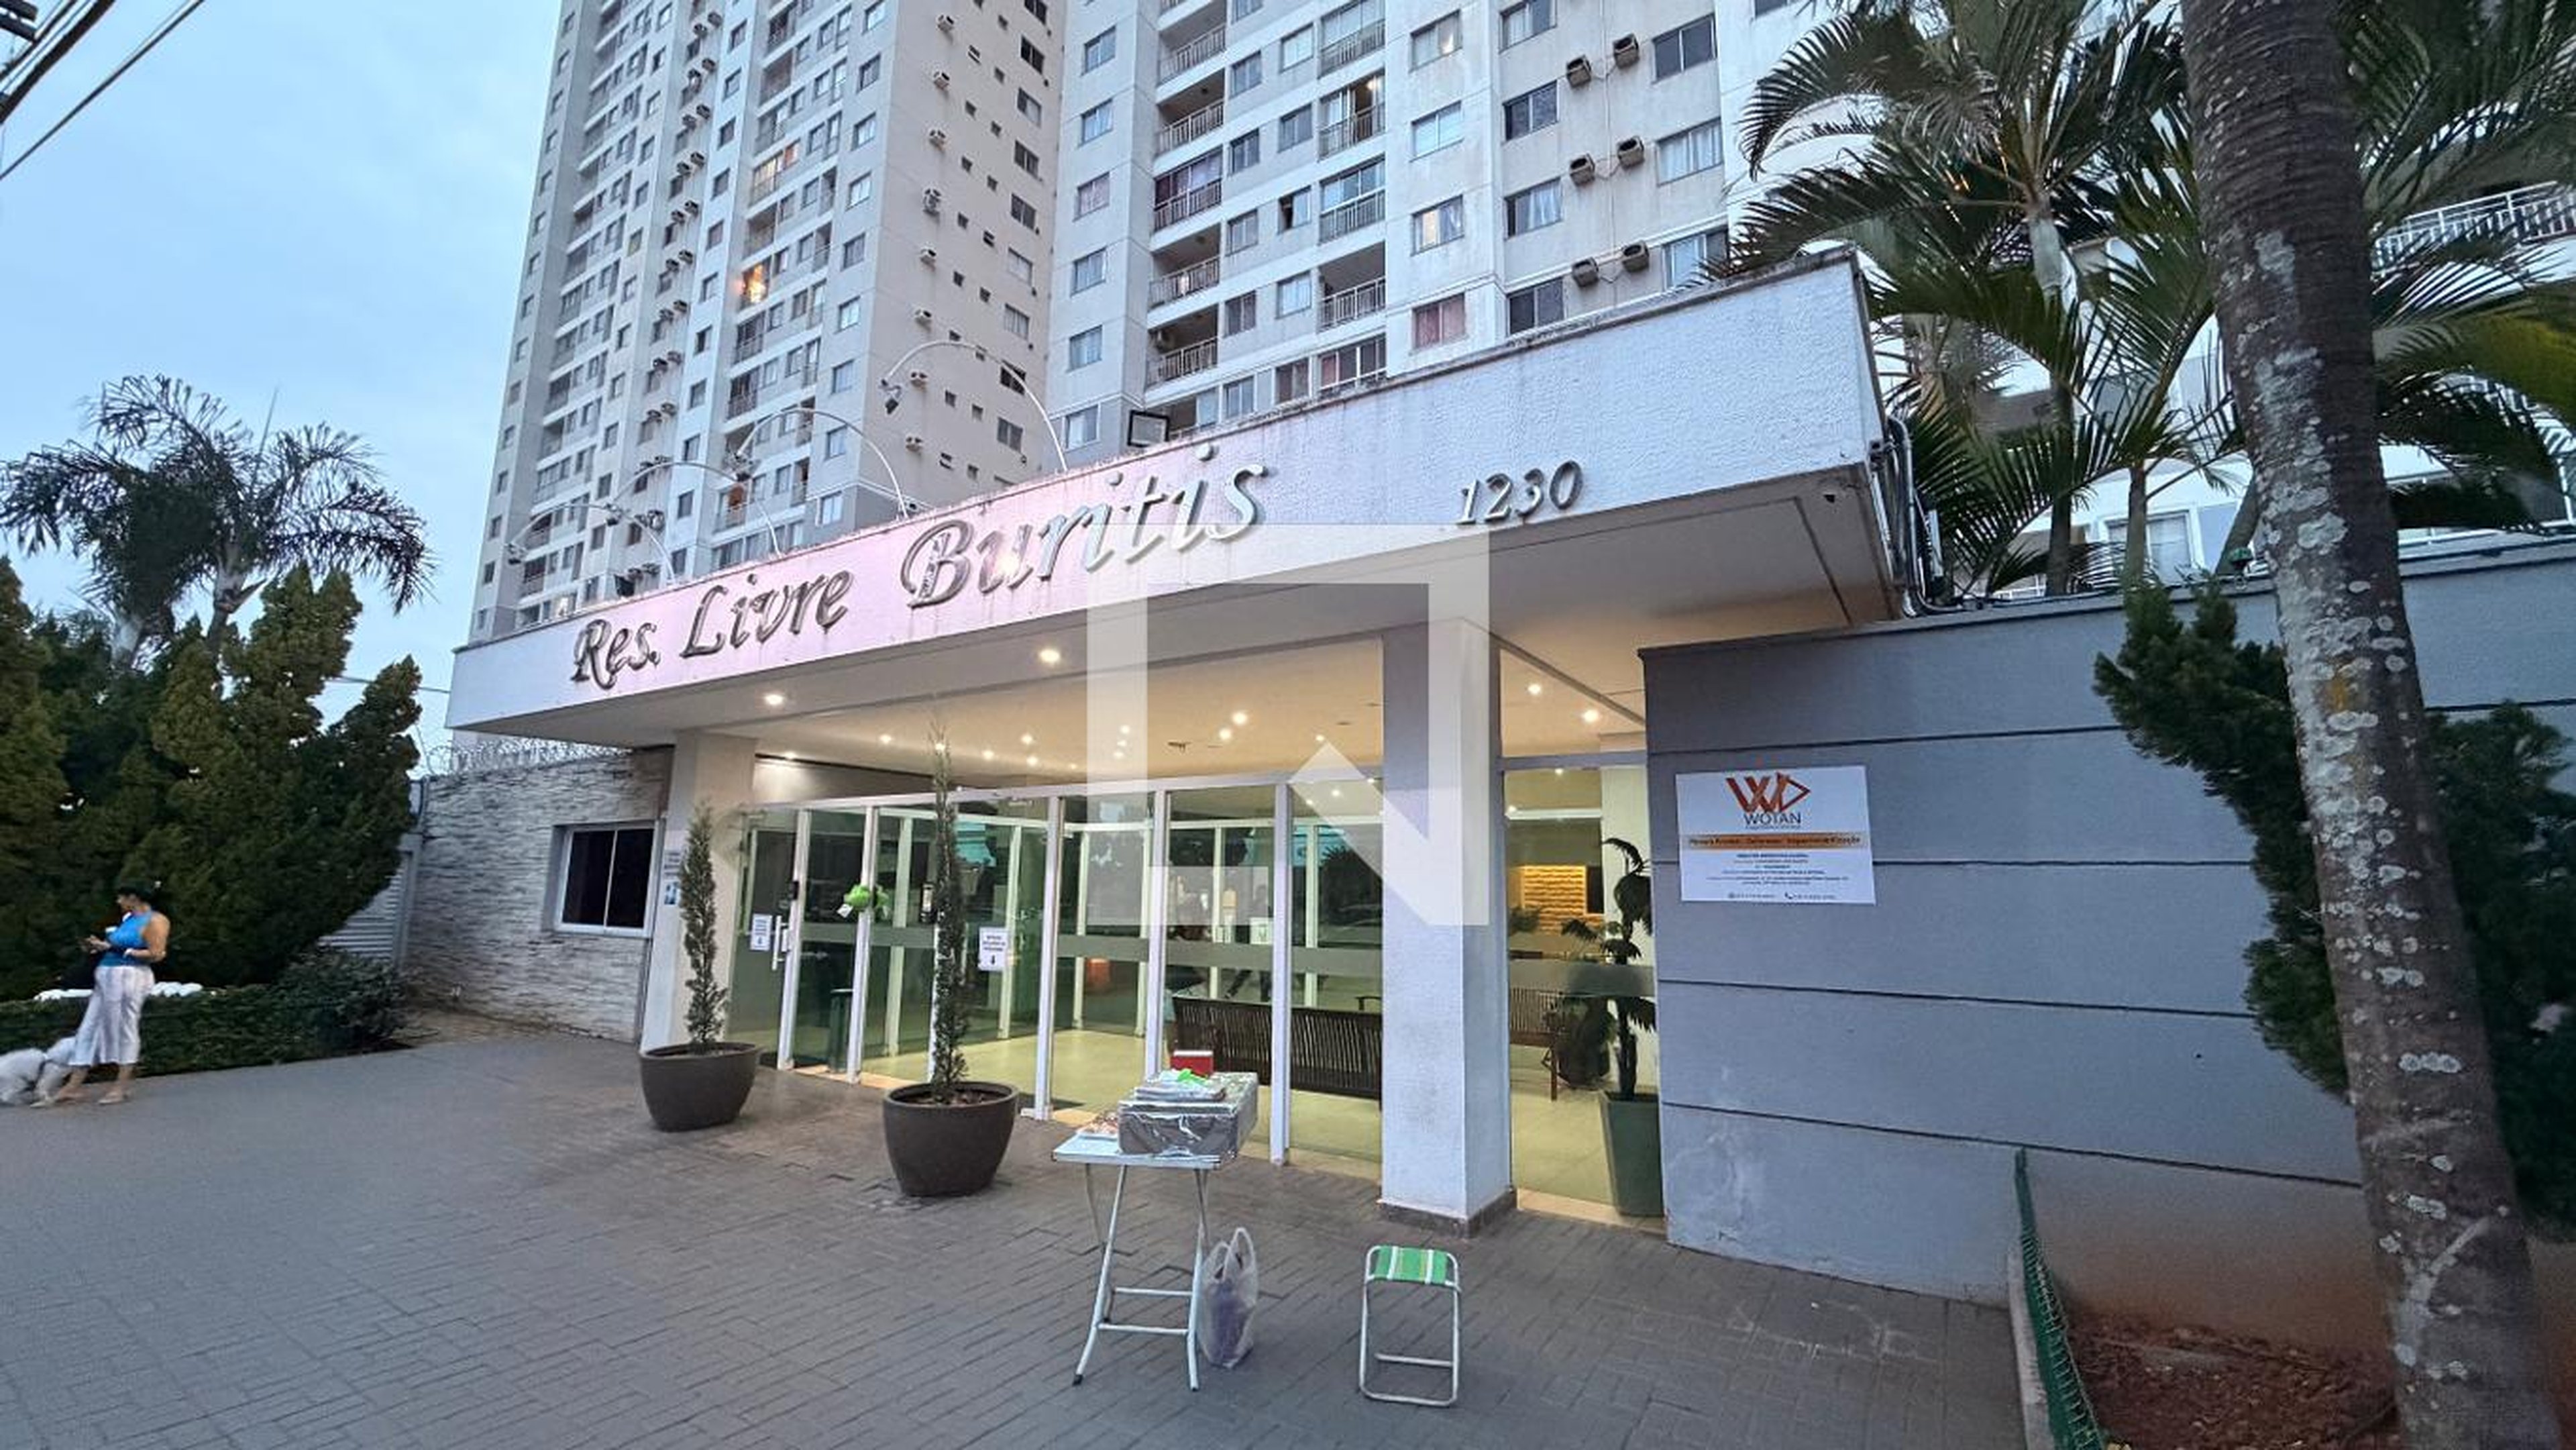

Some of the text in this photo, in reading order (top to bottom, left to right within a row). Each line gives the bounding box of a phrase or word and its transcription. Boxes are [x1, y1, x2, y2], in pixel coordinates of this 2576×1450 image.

[1456, 460, 1584, 525] 1230
[570, 444, 1271, 690] Res. Livre Buritis
[1743, 811, 1803, 826] WOTAN
